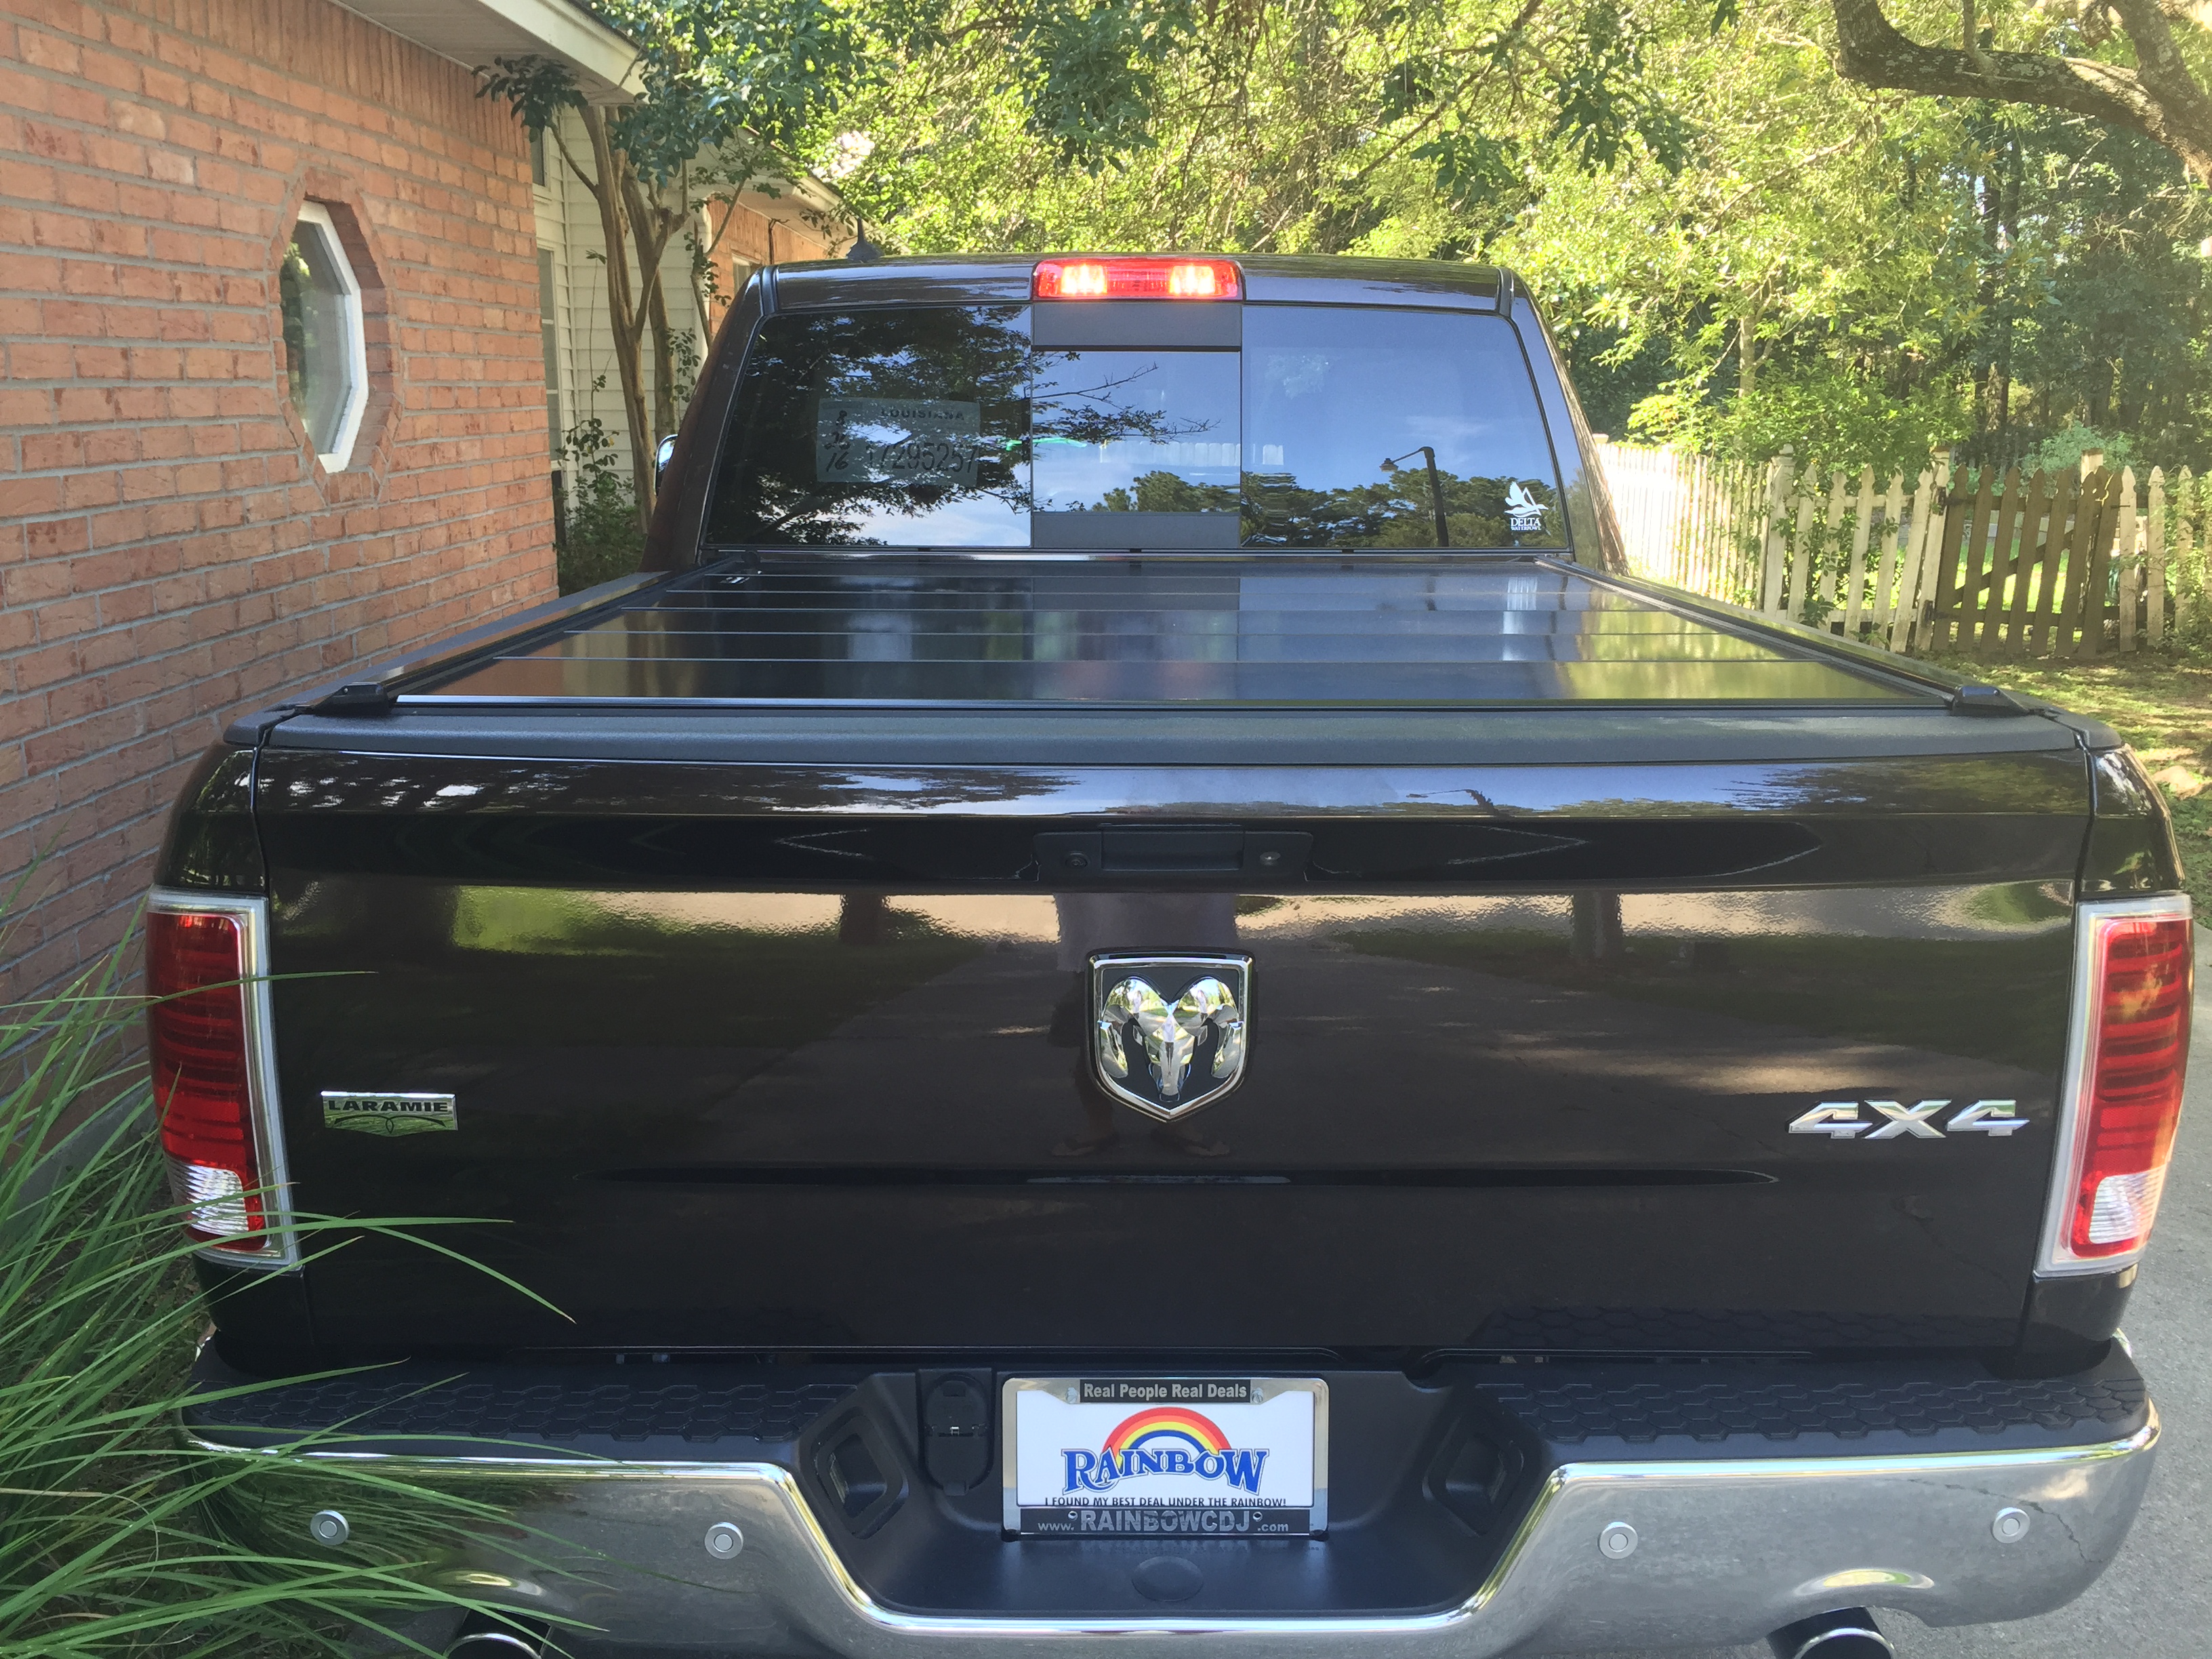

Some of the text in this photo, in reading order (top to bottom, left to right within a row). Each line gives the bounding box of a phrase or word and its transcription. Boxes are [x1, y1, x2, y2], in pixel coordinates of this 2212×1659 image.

[881, 409, 964, 420] LOUISIANA
[1510, 517, 1542, 526] DELTA
[328, 1100, 449, 1112] LARAMIE
[1785, 1099, 2030, 1139] 4X4
[1084, 1383, 1247, 1401] Real People Real Deals
[1061, 1445, 1270, 1496] RAINBOW
[1045, 1497, 1286, 1507] I FOUND MY BEST DEAL UNDER THE RAINBOW!
